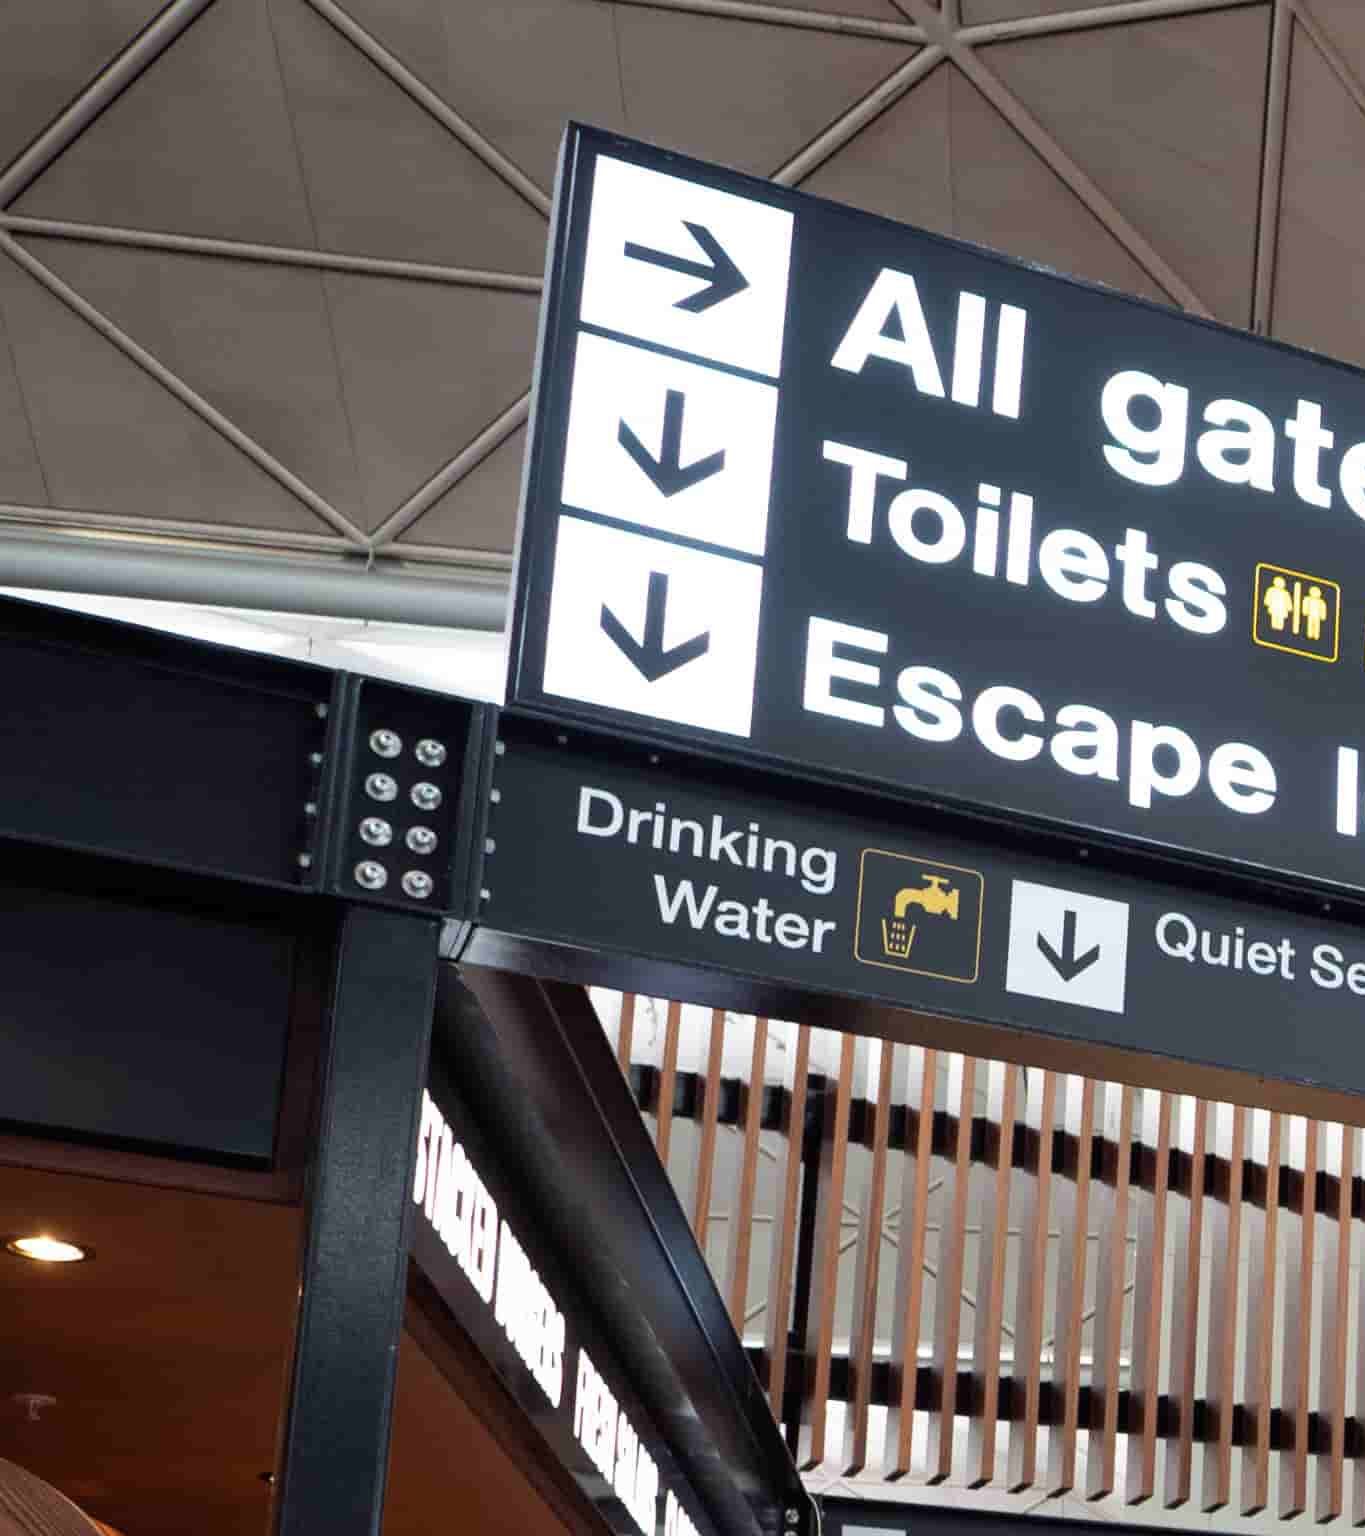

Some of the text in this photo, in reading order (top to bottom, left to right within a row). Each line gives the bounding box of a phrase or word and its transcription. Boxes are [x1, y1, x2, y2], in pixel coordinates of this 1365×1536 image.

[830, 267, 1027, 420] All
[822, 439, 1228, 634] Toilets
[802, 615, 1278, 815] Escape
[575, 786, 838, 895] Drinking
[653, 874, 836, 953] Water
[1155, 911, 1296, 982] Quiet
